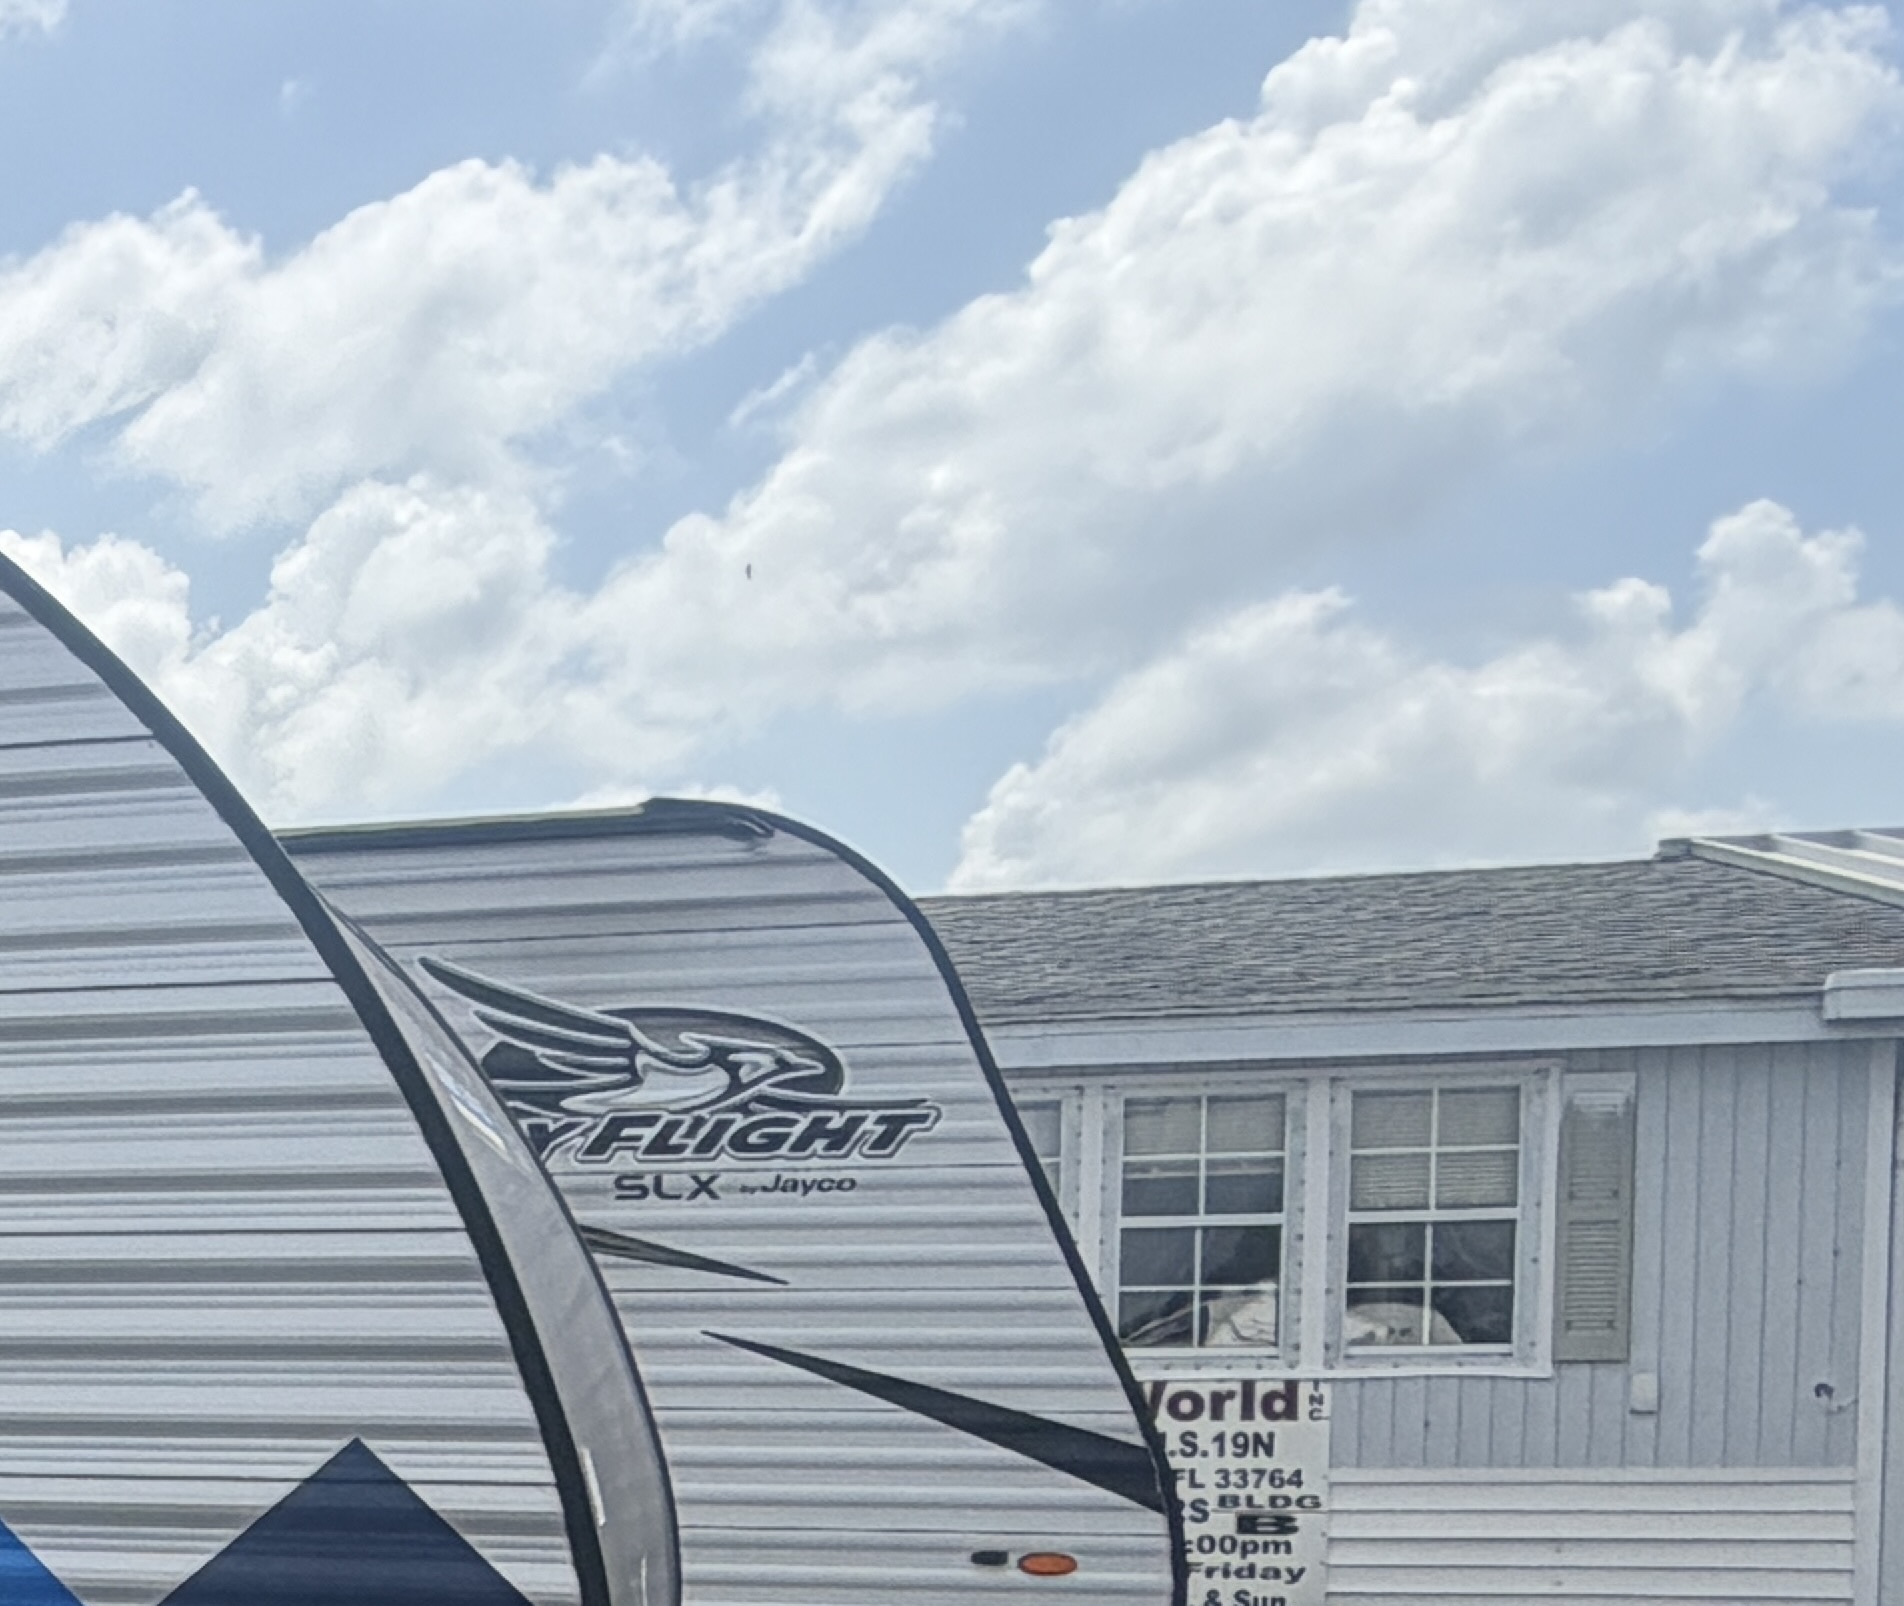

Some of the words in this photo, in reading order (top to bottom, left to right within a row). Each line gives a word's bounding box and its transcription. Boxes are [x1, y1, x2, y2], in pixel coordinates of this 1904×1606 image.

[579, 1109, 936, 1160] FLIGHT
[615, 1174, 720, 1200] SLX
[760, 1173, 857, 1197] Jayco
[1160, 1431, 1275, 1458] .S.19N
[1214, 1468, 1303, 1489] 33764
[1217, 1495, 1322, 1509] BLDG
